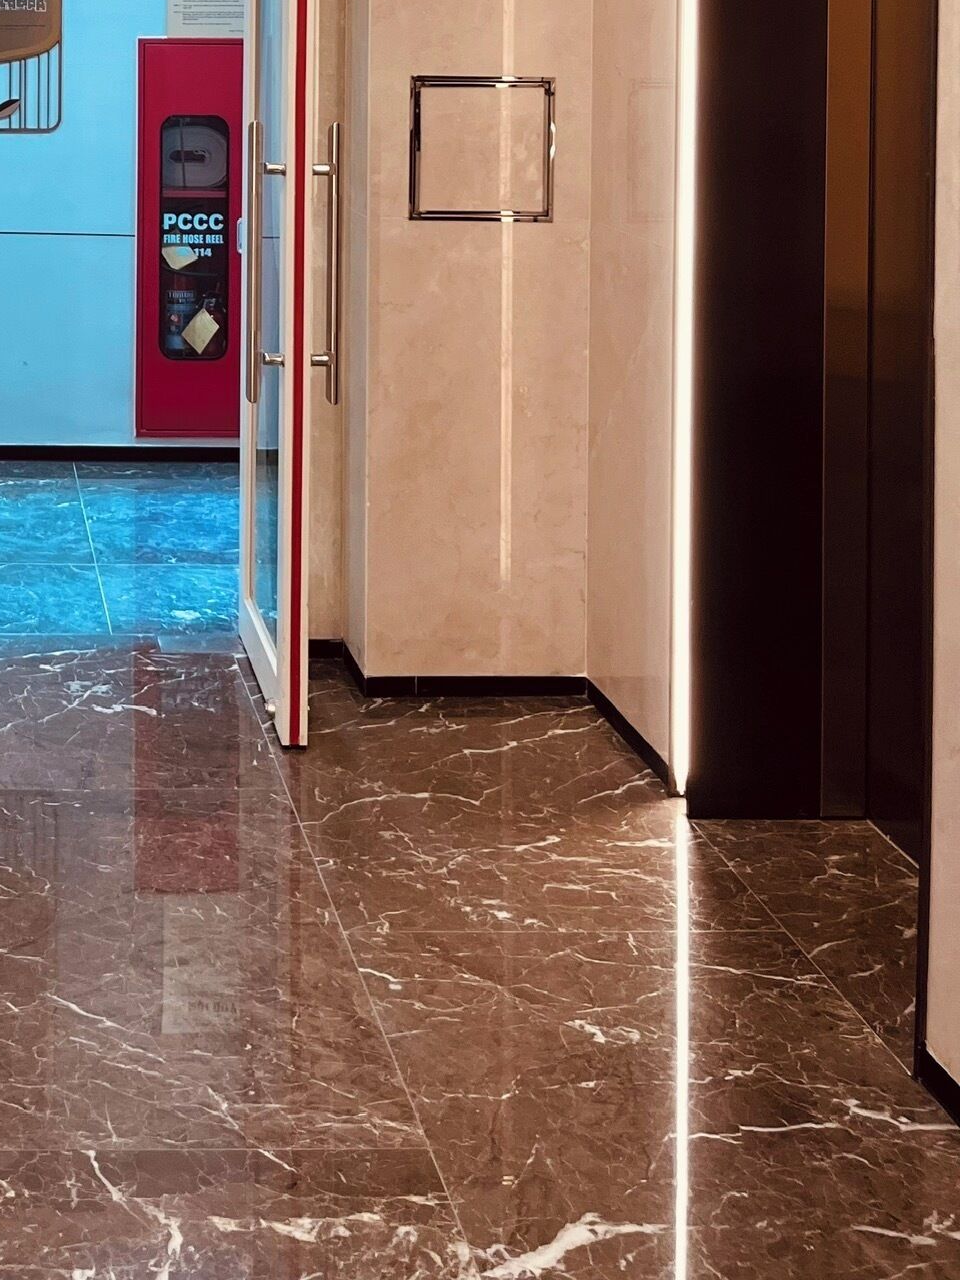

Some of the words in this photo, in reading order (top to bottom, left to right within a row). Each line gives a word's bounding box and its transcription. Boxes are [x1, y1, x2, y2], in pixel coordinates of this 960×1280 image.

[163, 213, 224, 230] PCCC
[163, 234, 181, 244] FIRE
[182, 234, 204, 244] HOSE
[205, 234, 224, 244] REEL
[193, 247, 212, 257] 114
